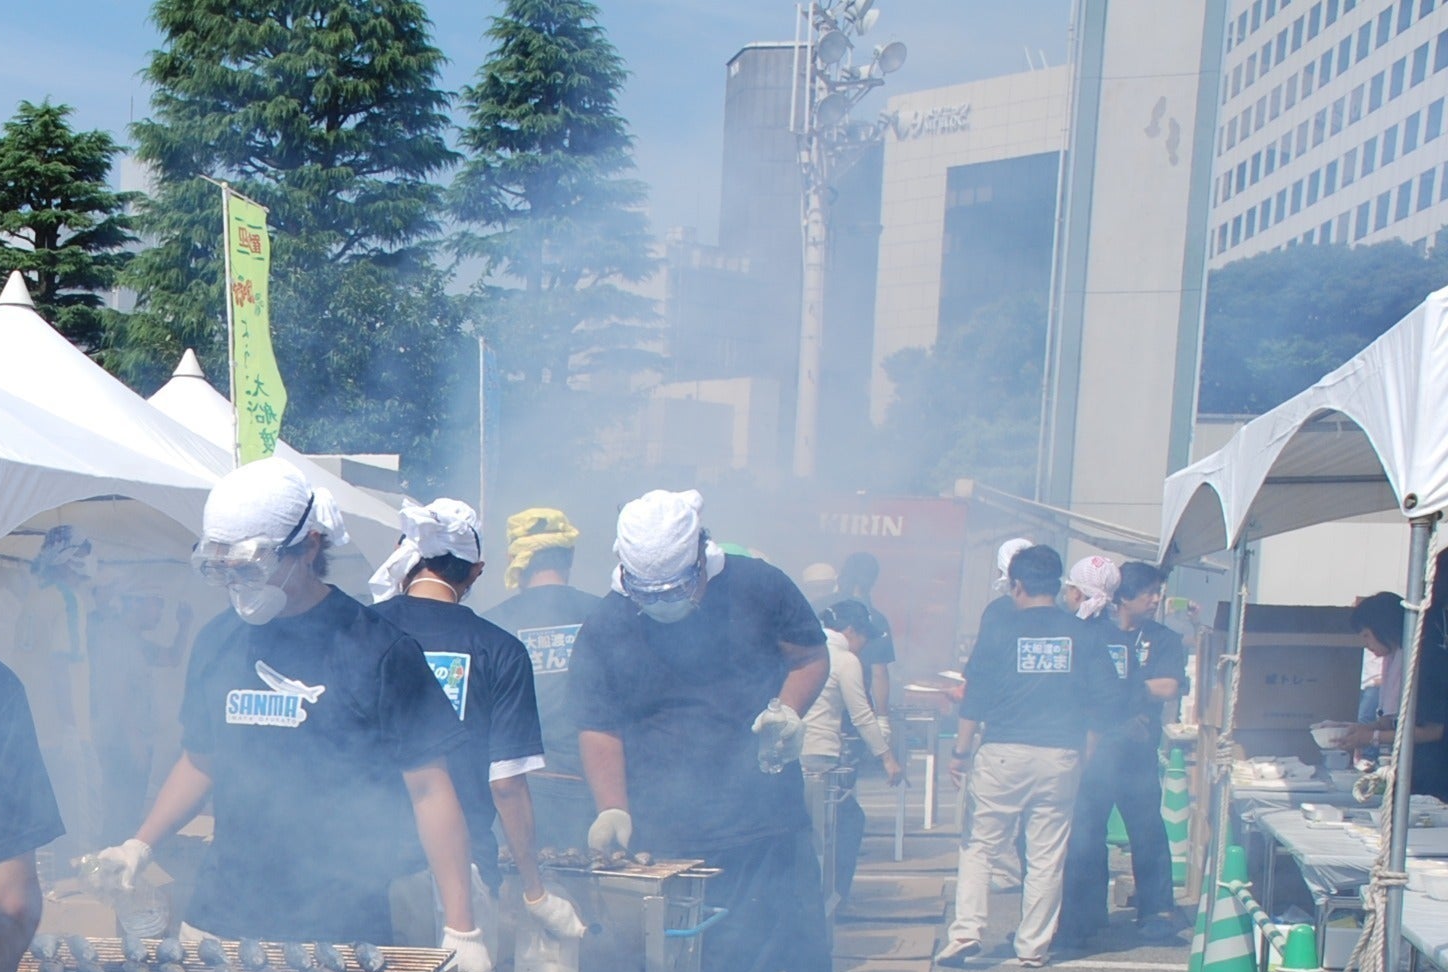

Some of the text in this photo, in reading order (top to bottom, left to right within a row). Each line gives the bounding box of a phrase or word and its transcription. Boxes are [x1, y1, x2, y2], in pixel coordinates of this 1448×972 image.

[818, 512, 904, 537] KIRIN
[532, 648, 573, 670] さん
[1021, 654, 1068, 670] さんま
[228, 692, 299, 719] SANMA
